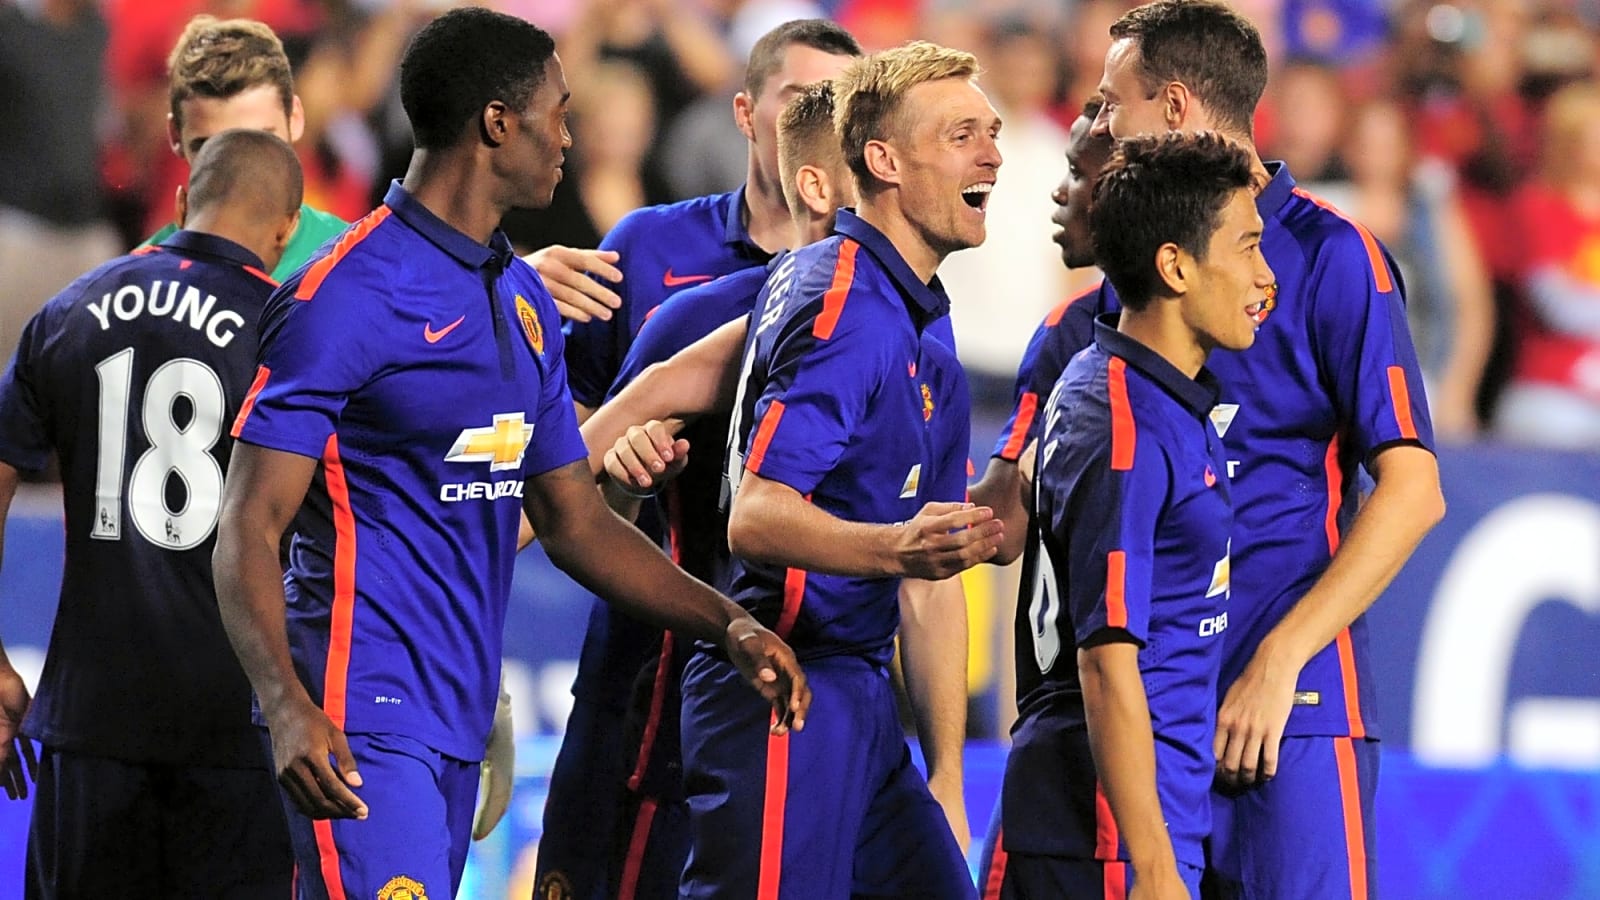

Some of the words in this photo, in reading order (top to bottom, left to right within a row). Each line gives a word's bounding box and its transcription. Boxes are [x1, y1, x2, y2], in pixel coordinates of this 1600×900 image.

[86, 280, 245, 348] YOUNG
[90, 346, 226, 552] 18
[375, 696, 402, 705] DRI-FIT
